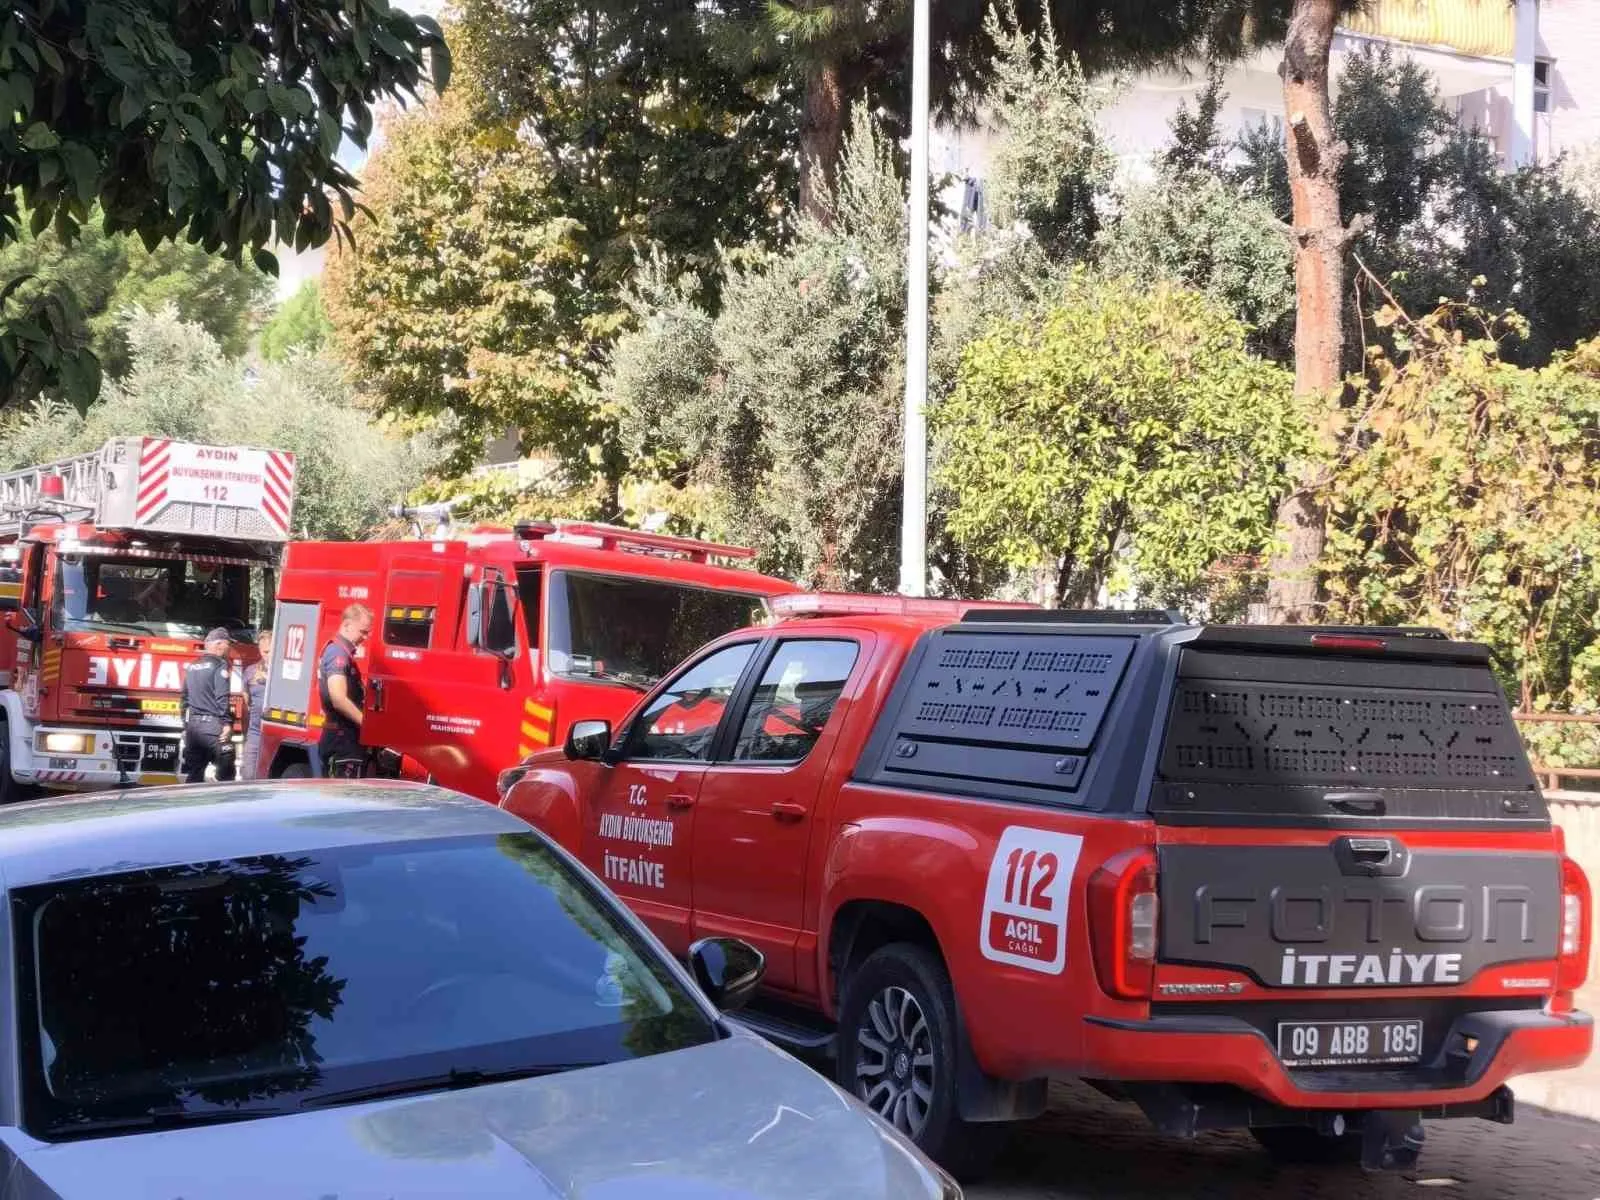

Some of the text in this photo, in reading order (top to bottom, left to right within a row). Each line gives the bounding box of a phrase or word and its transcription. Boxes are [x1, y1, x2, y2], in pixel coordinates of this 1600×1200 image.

[196, 449, 238, 461] AYDIN
[203, 485, 228, 500] 112
[286, 626, 304, 658] 112
[629, 784, 647, 806] T.C.
[599, 811, 673, 851] AYDIN BÜYÜKŞEHİR
[604, 848, 665, 889] İTFAİYE
[1003, 848, 1058, 911] 112
[1194, 884, 1534, 944] FOTON
[1280, 948, 1463, 985] İTFAİYE
[1292, 1025, 1418, 1055] 09 ABB 185
